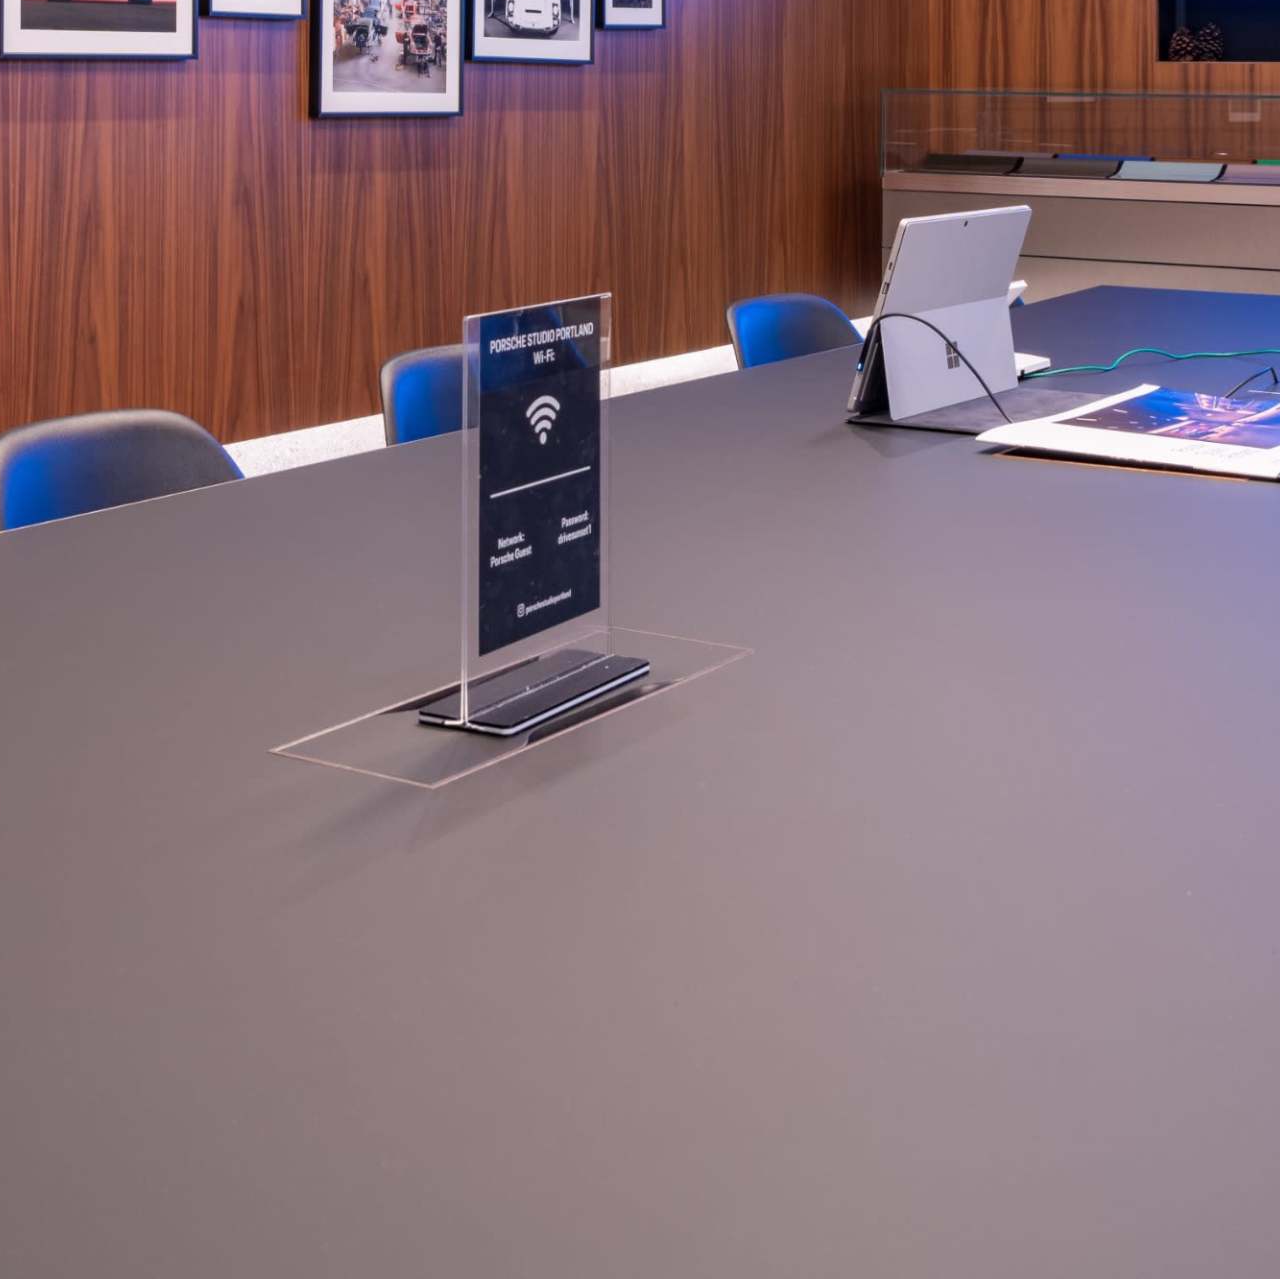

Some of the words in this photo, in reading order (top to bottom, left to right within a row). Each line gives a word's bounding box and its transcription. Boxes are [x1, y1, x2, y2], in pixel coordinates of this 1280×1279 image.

[490, 334, 527, 354] PORSCHE
[527, 329, 555, 347] STUDIO
[555, 322, 594, 341] PORTLAND
[490, 552, 514, 568] Porsche
[514, 545, 532, 560] Guest
